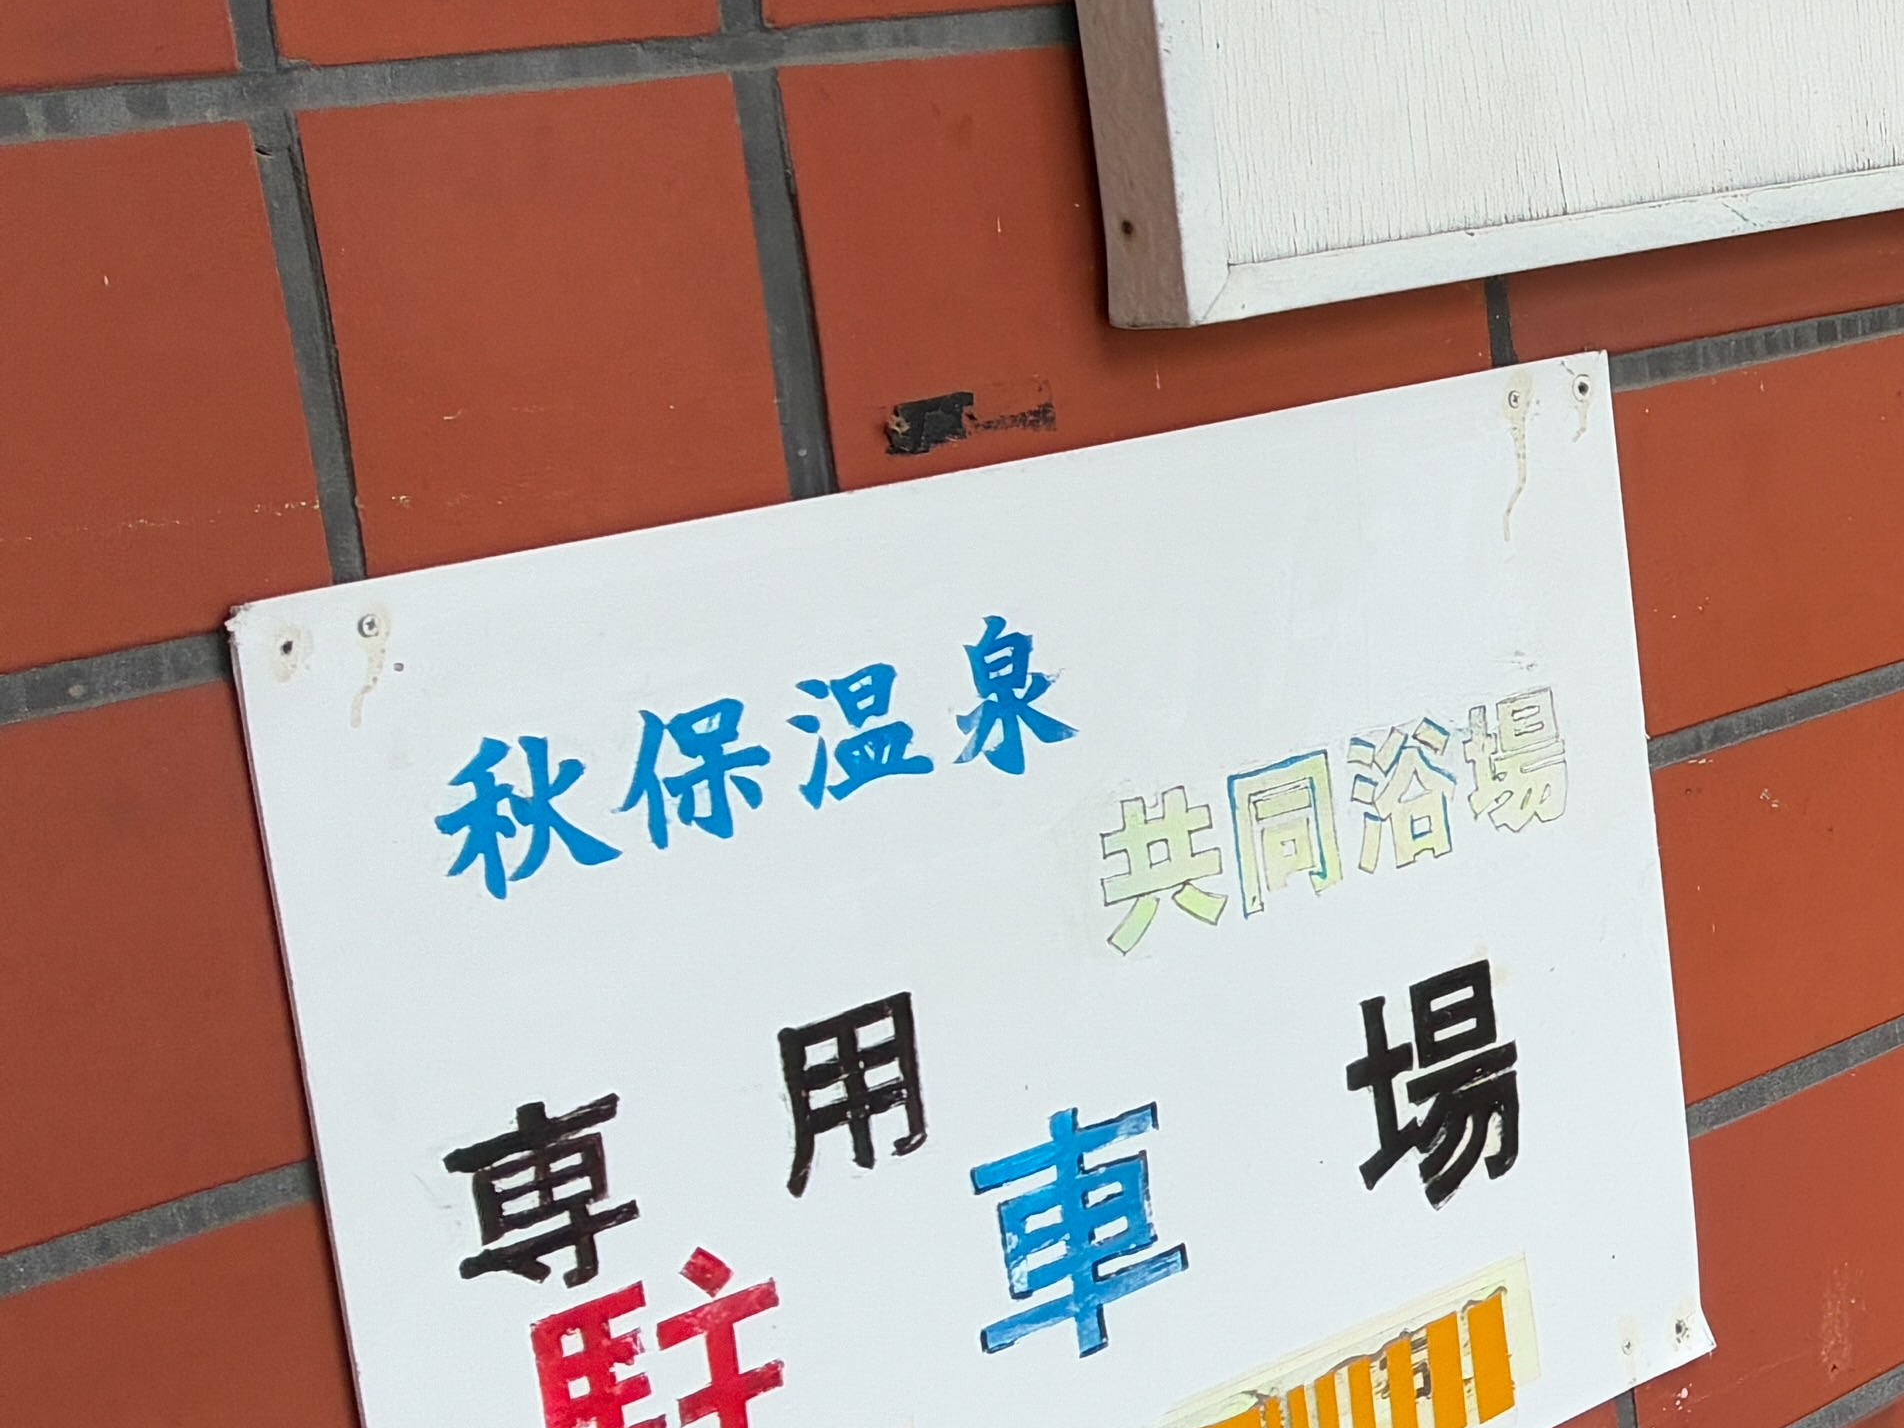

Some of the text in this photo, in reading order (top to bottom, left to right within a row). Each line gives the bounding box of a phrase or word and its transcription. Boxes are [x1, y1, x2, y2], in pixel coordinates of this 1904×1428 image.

[434, 614, 1081, 900] 秋保温泉
[1096, 684, 1571, 957] 共同浴場
